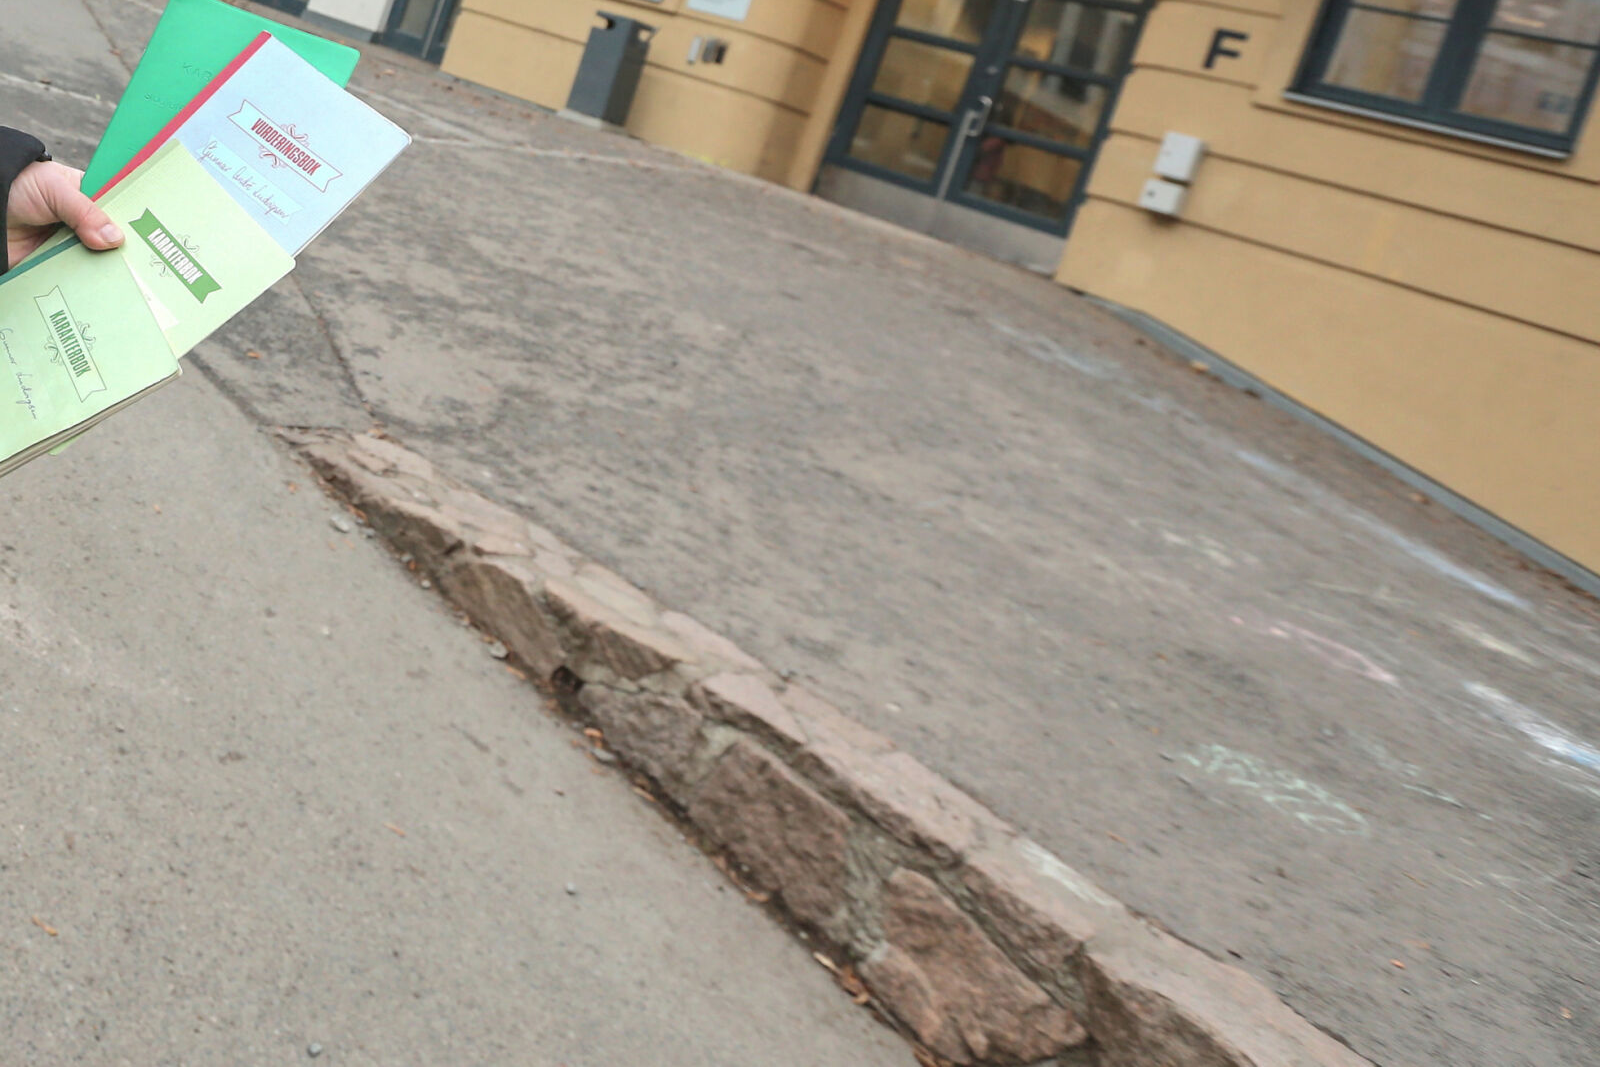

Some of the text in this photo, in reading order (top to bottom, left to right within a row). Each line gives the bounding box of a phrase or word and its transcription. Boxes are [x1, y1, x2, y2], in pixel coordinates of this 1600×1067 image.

[1204, 28, 1249, 70] F
[250, 117, 322, 176] VURDERINGSBOK
[147, 227, 203, 285] KARAKTERBOK
[49, 309, 92, 378] KARAKTERBOK
